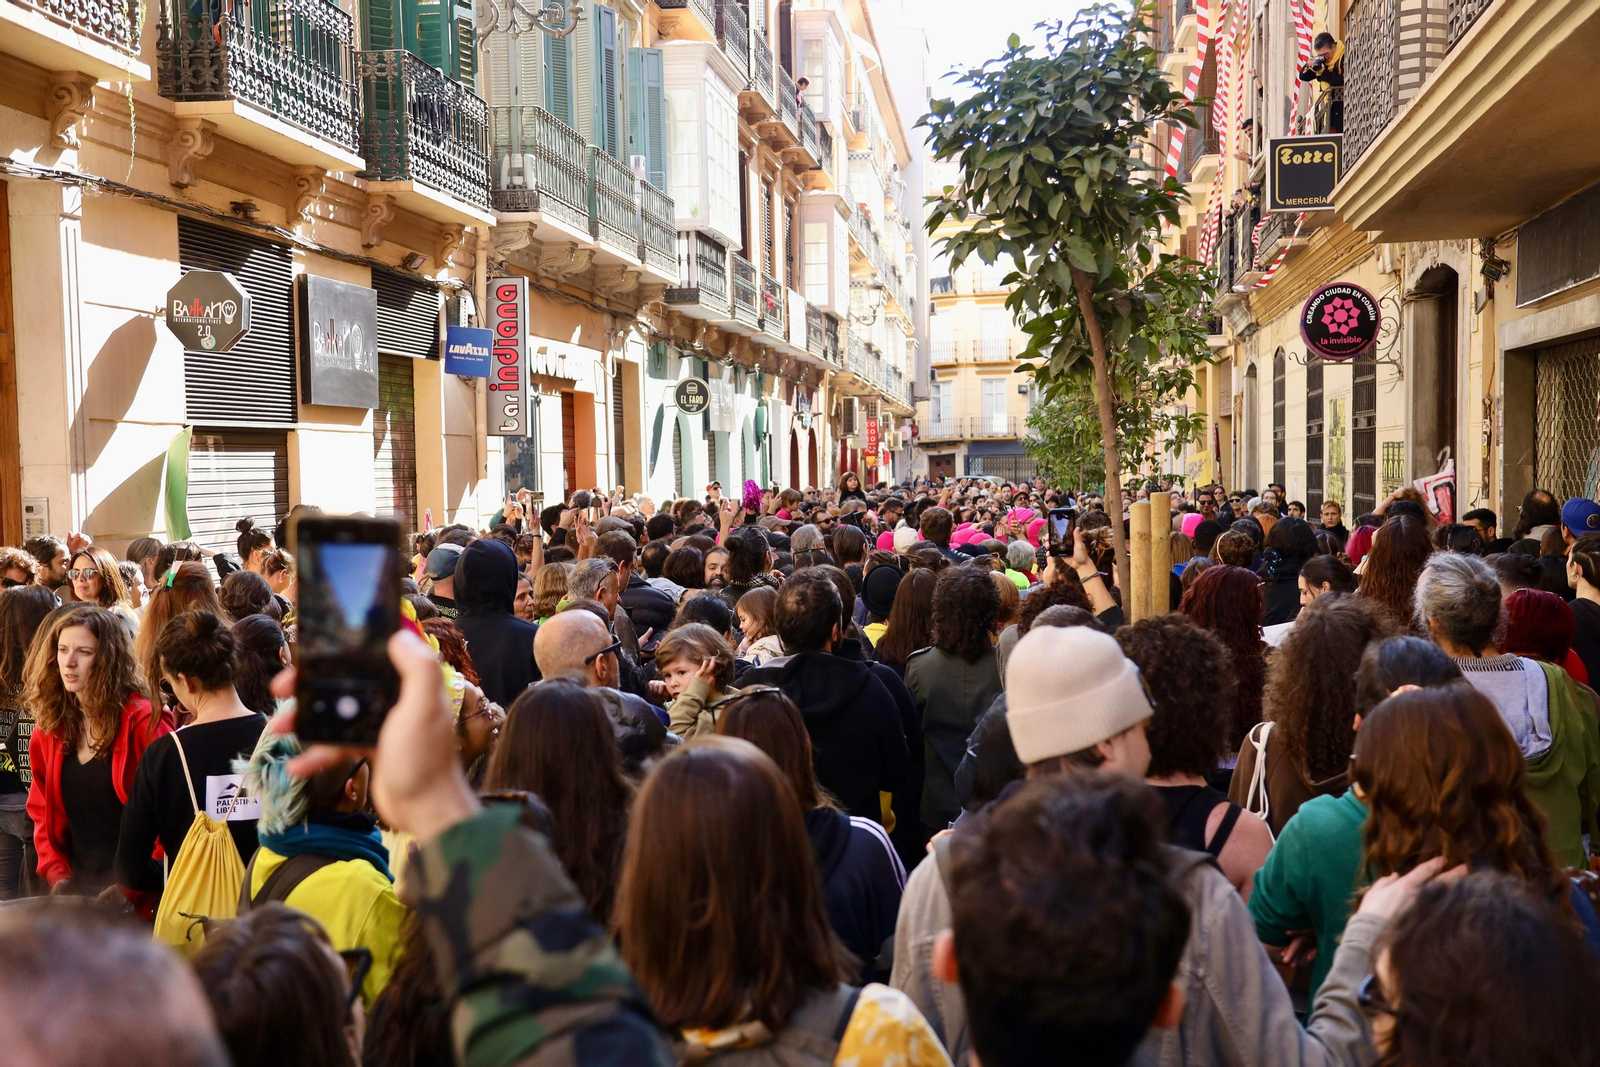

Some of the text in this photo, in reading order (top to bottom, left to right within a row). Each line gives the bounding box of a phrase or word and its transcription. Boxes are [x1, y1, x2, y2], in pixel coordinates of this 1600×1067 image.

[1286, 196, 1327, 205] MERCERÍA
[1307, 287, 1376, 324] CREANDO CIUDAD EN COMÚN
[198, 325, 211, 337] 2.0
[1321, 335, 1362, 345] la invisible
[448, 343, 489, 357] LAVAZZA
[489, 284, 520, 432] bar indiana
[681, 395, 703, 404] EL FARO
